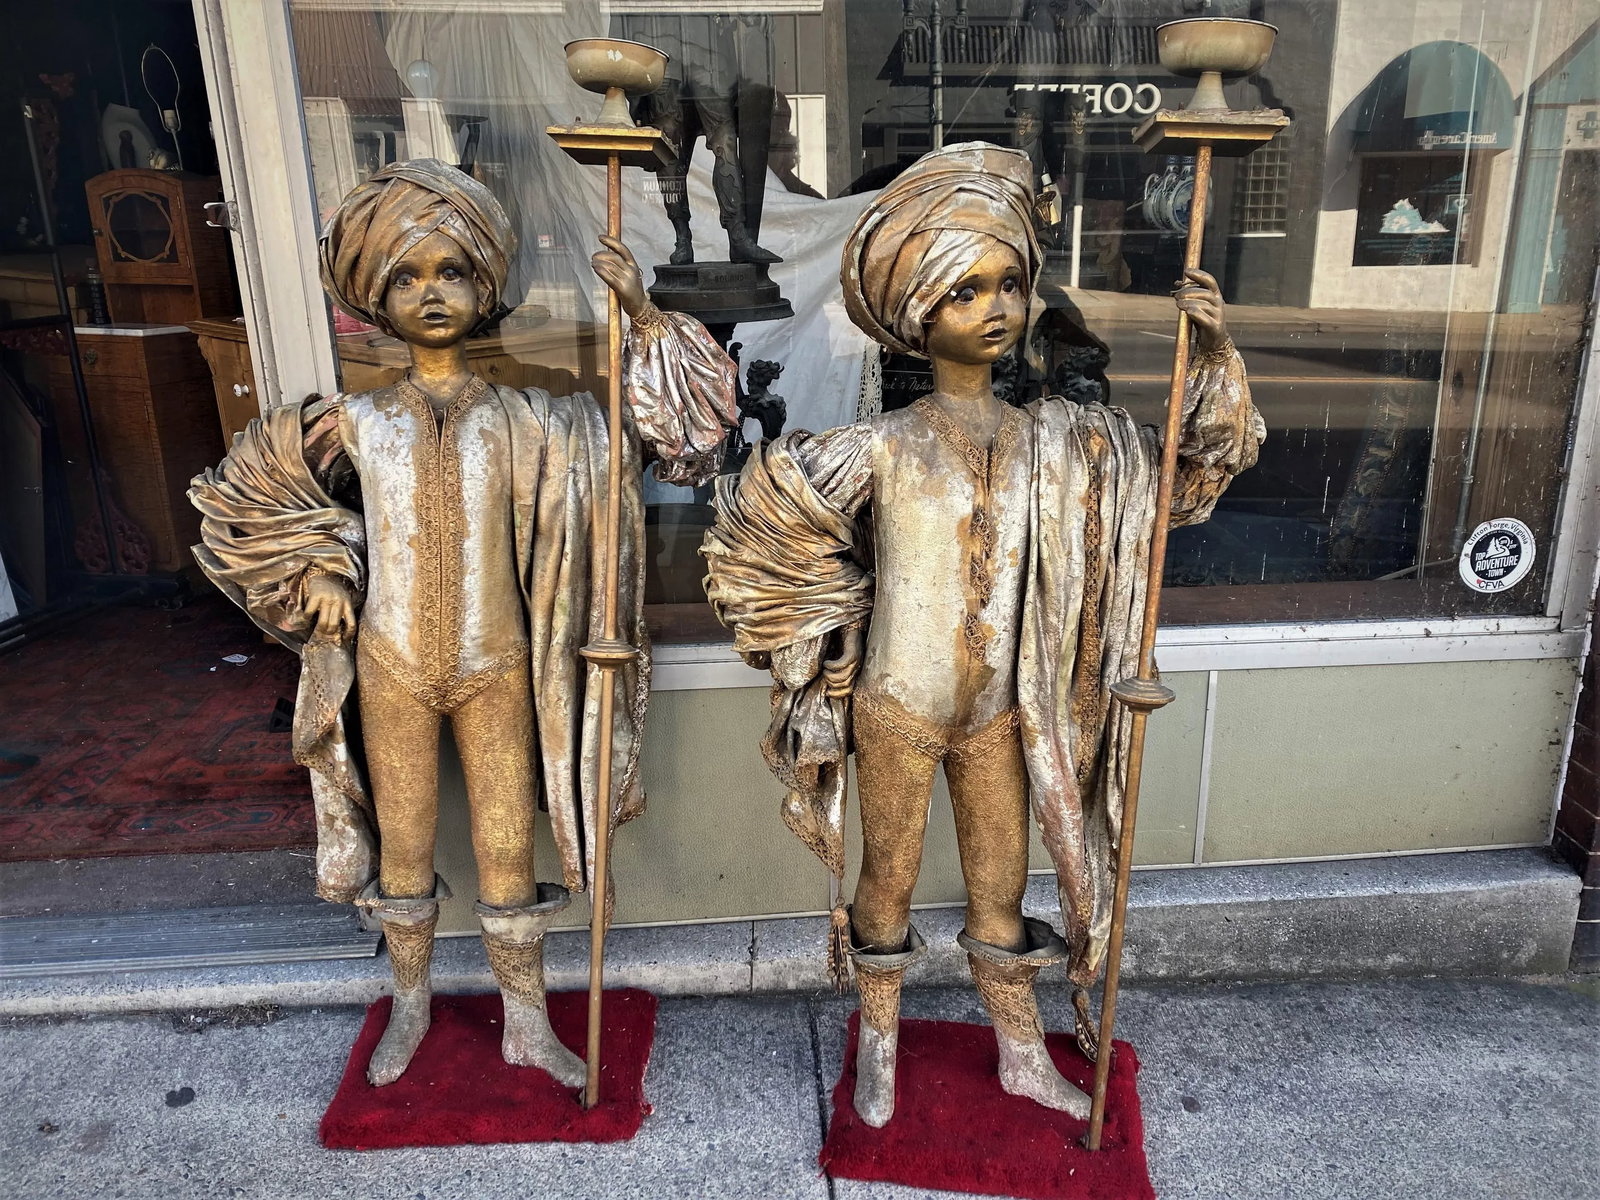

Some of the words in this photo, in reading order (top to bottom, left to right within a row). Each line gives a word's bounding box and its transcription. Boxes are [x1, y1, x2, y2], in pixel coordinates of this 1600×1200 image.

[1467, 526, 1488, 545] Clifton
[1511, 523, 1528, 545] Virginia
[1475, 552, 1487, 561] TOP
[1475, 555, 1519, 572] ADVENTURE
[1479, 581, 1505, 589] CFVA
